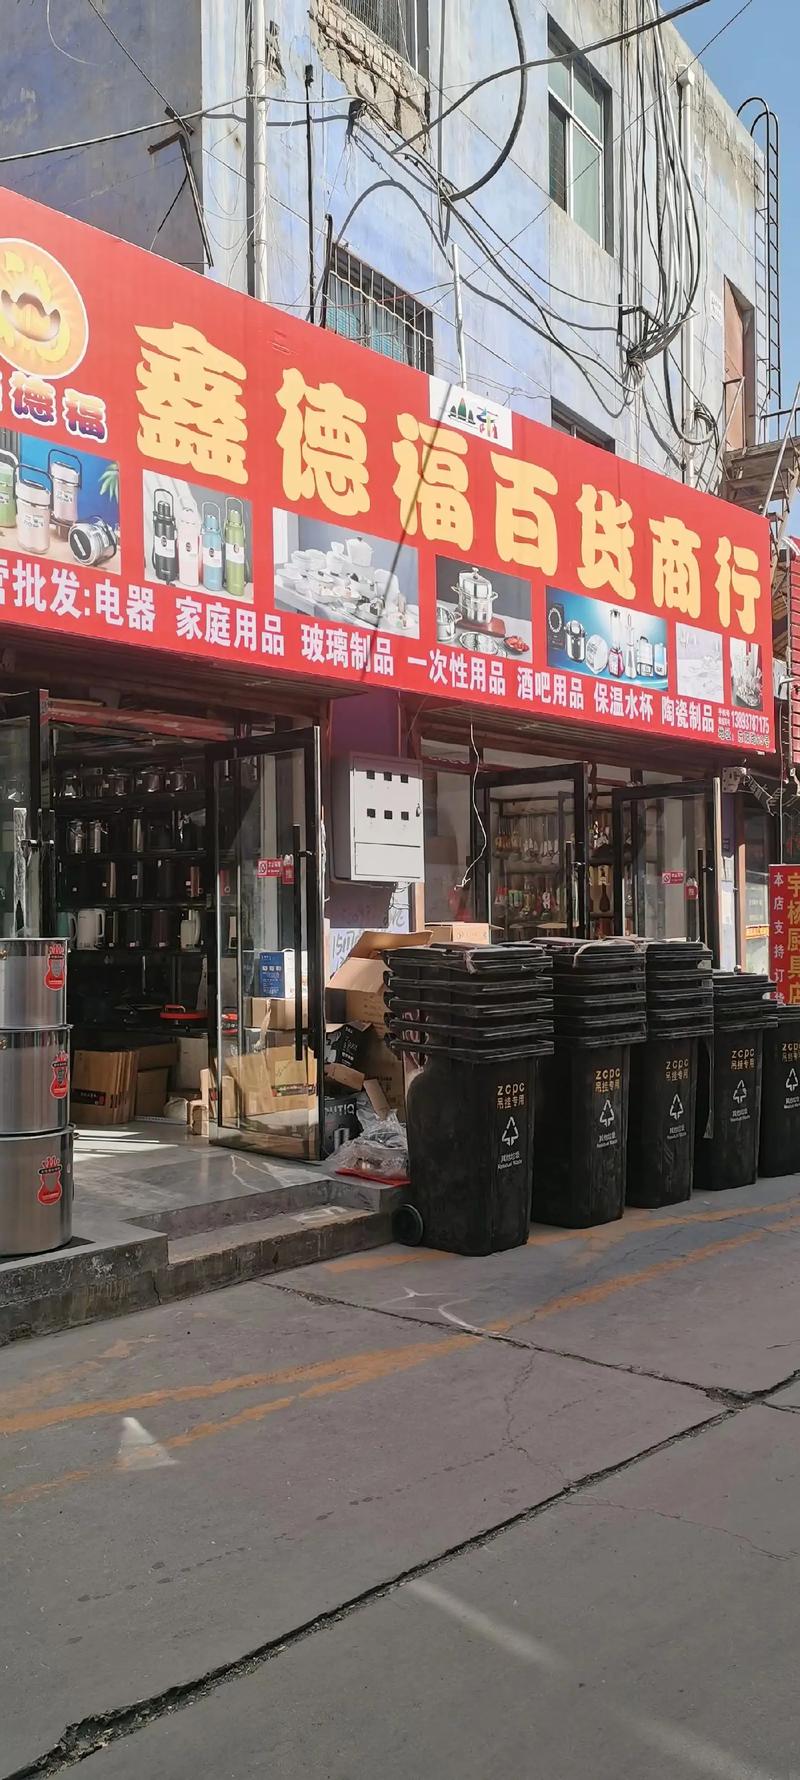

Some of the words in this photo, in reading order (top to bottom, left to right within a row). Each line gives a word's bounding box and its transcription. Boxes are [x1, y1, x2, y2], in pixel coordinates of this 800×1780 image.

[0, 370, 107, 444] 德福
[134, 320, 761, 634] 鑫德福百货商行
[175, 596, 284, 657] 家庭用品
[301, 623, 394, 676] 玻璃制品
[407, 649, 506, 696] 一次性用品
[517, 667, 584, 710] 酒吧用品
[593, 682, 653, 722] 保温水杯
[661, 696, 714, 733] 陶瓷制品
[731, 1048, 755, 1059] zcpc
[782, 1043, 800, 1051] zcp
[665, 1059, 689, 1070] zcpc
[595, 1068, 620, 1082] zcpc
[497, 1082, 525, 1096] zcpc
[496, 1094, 525, 1109] 吊挂专用
